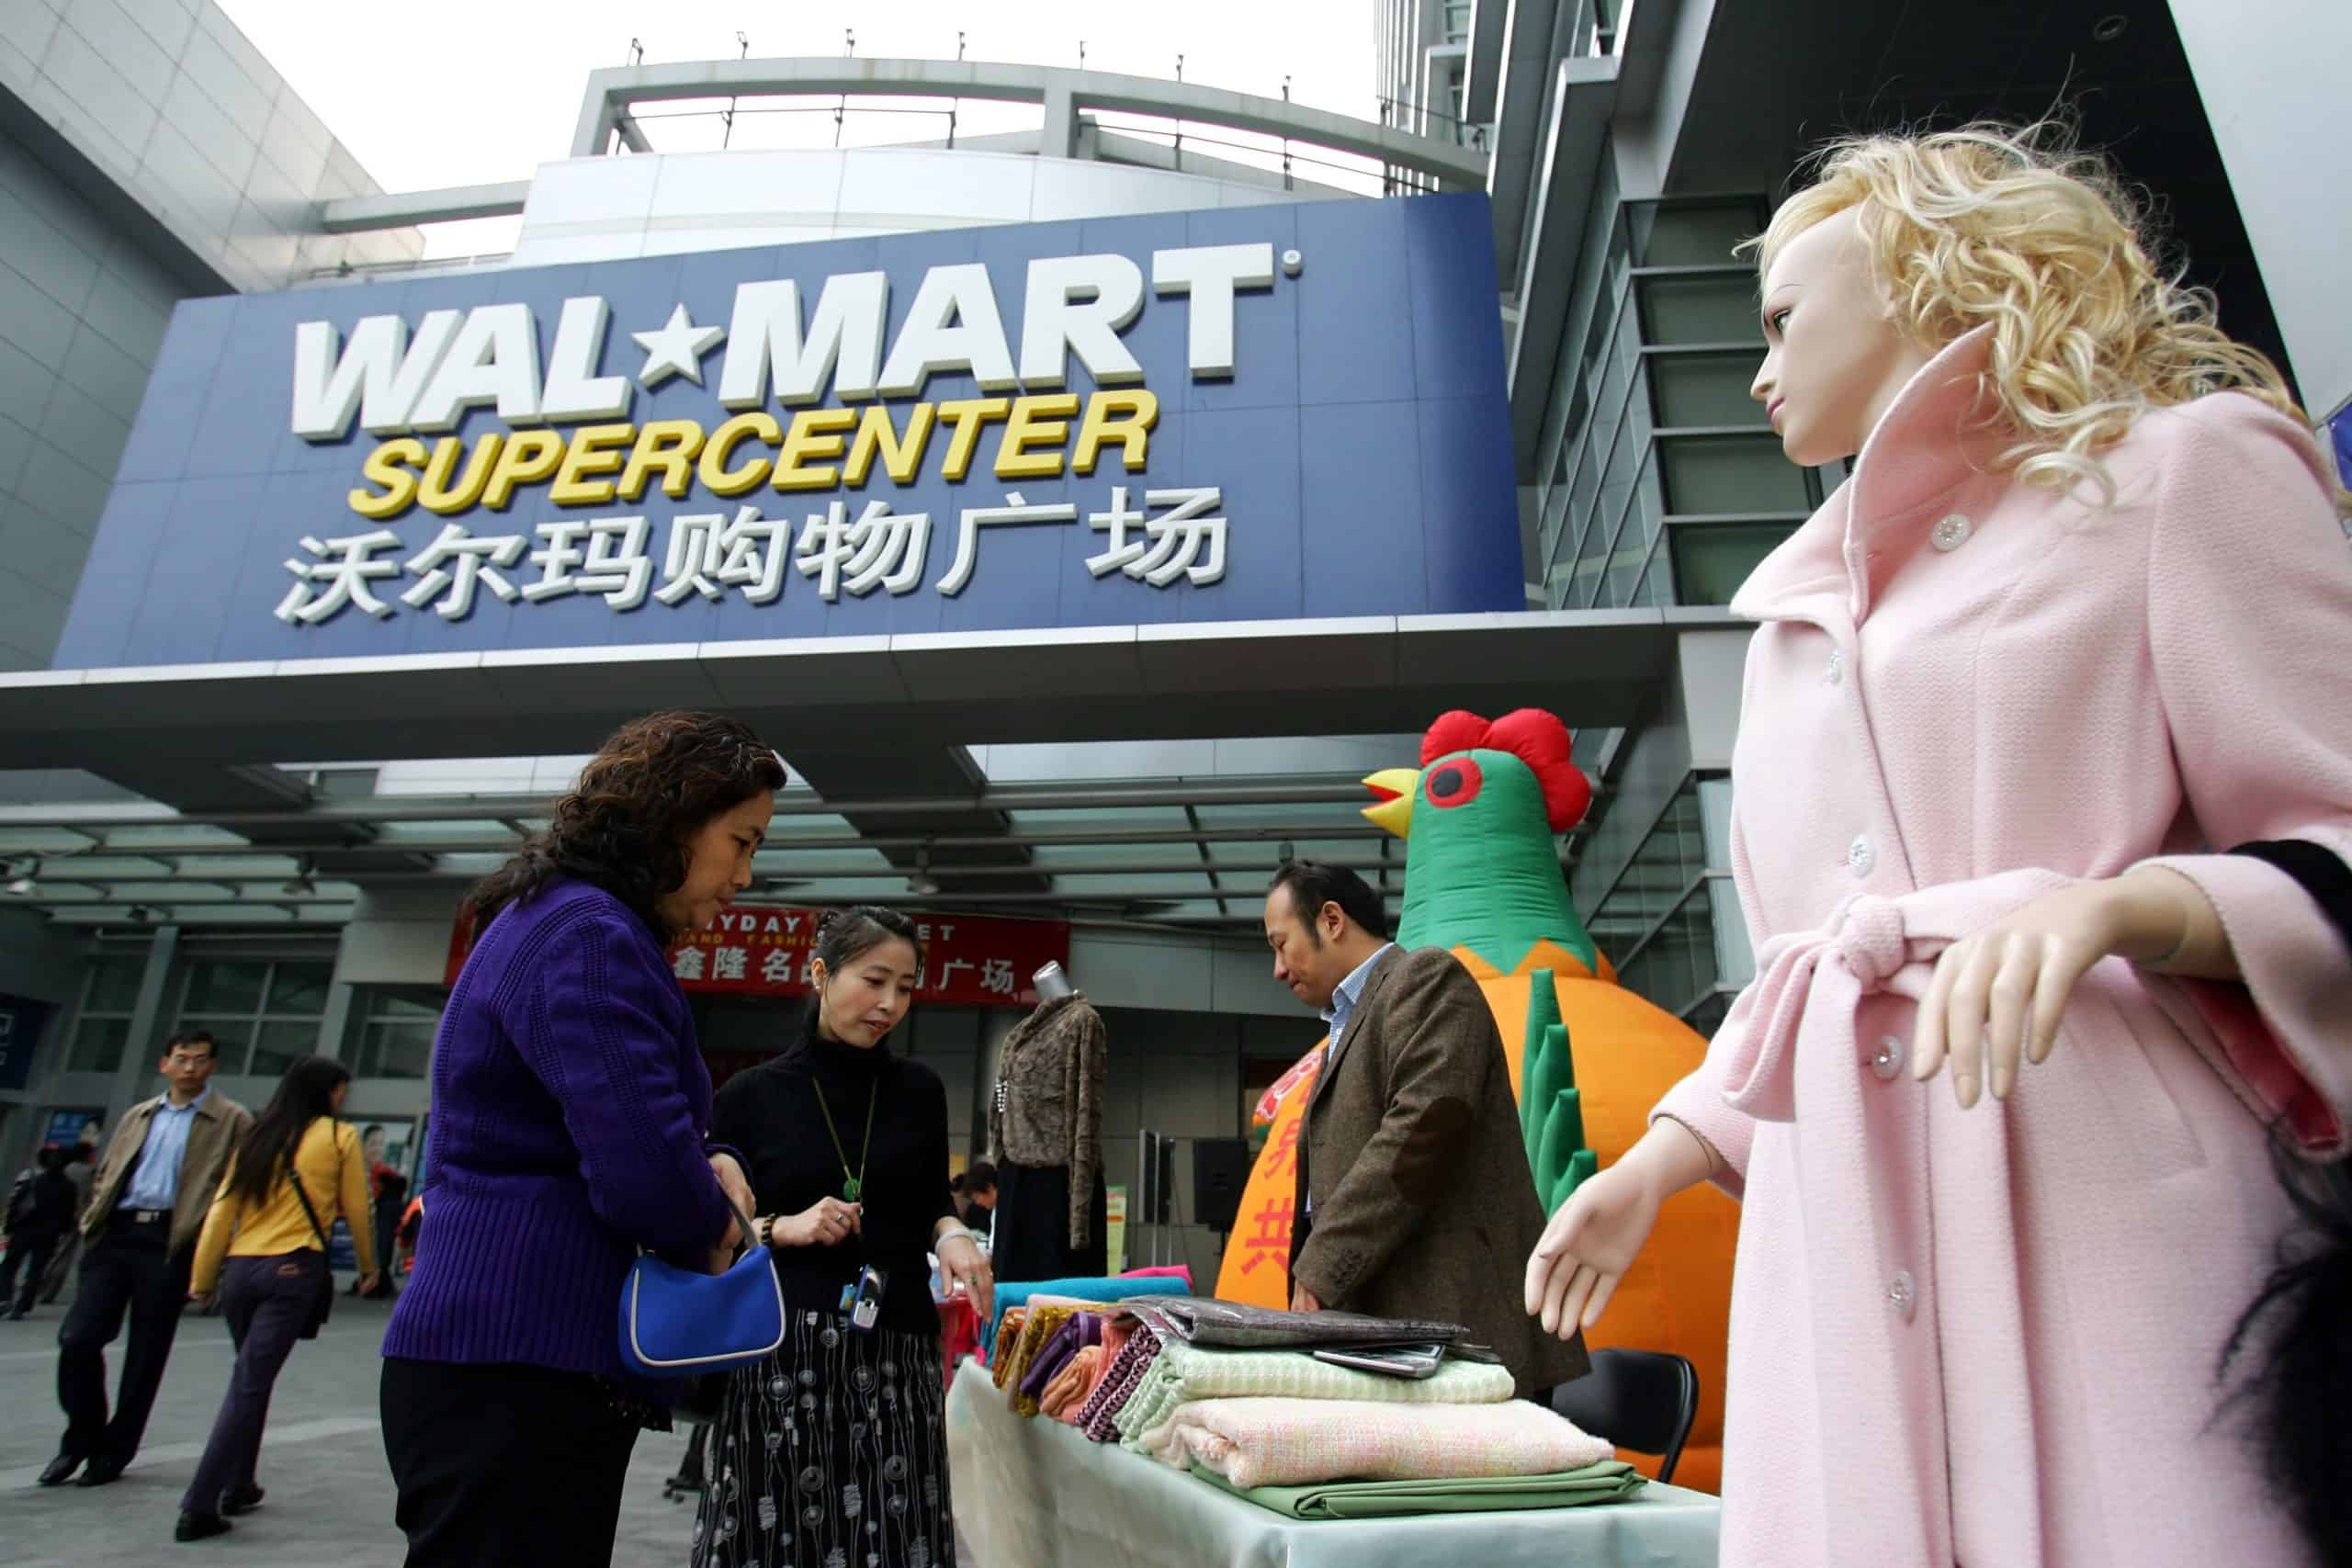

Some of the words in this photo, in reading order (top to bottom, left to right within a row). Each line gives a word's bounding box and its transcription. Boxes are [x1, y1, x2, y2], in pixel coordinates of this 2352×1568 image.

[347, 389, 1158, 518] SUPERCENTER
[275, 486, 1229, 624] 沃尔玛购物广场
[915, 957, 1015, 994] 广场
